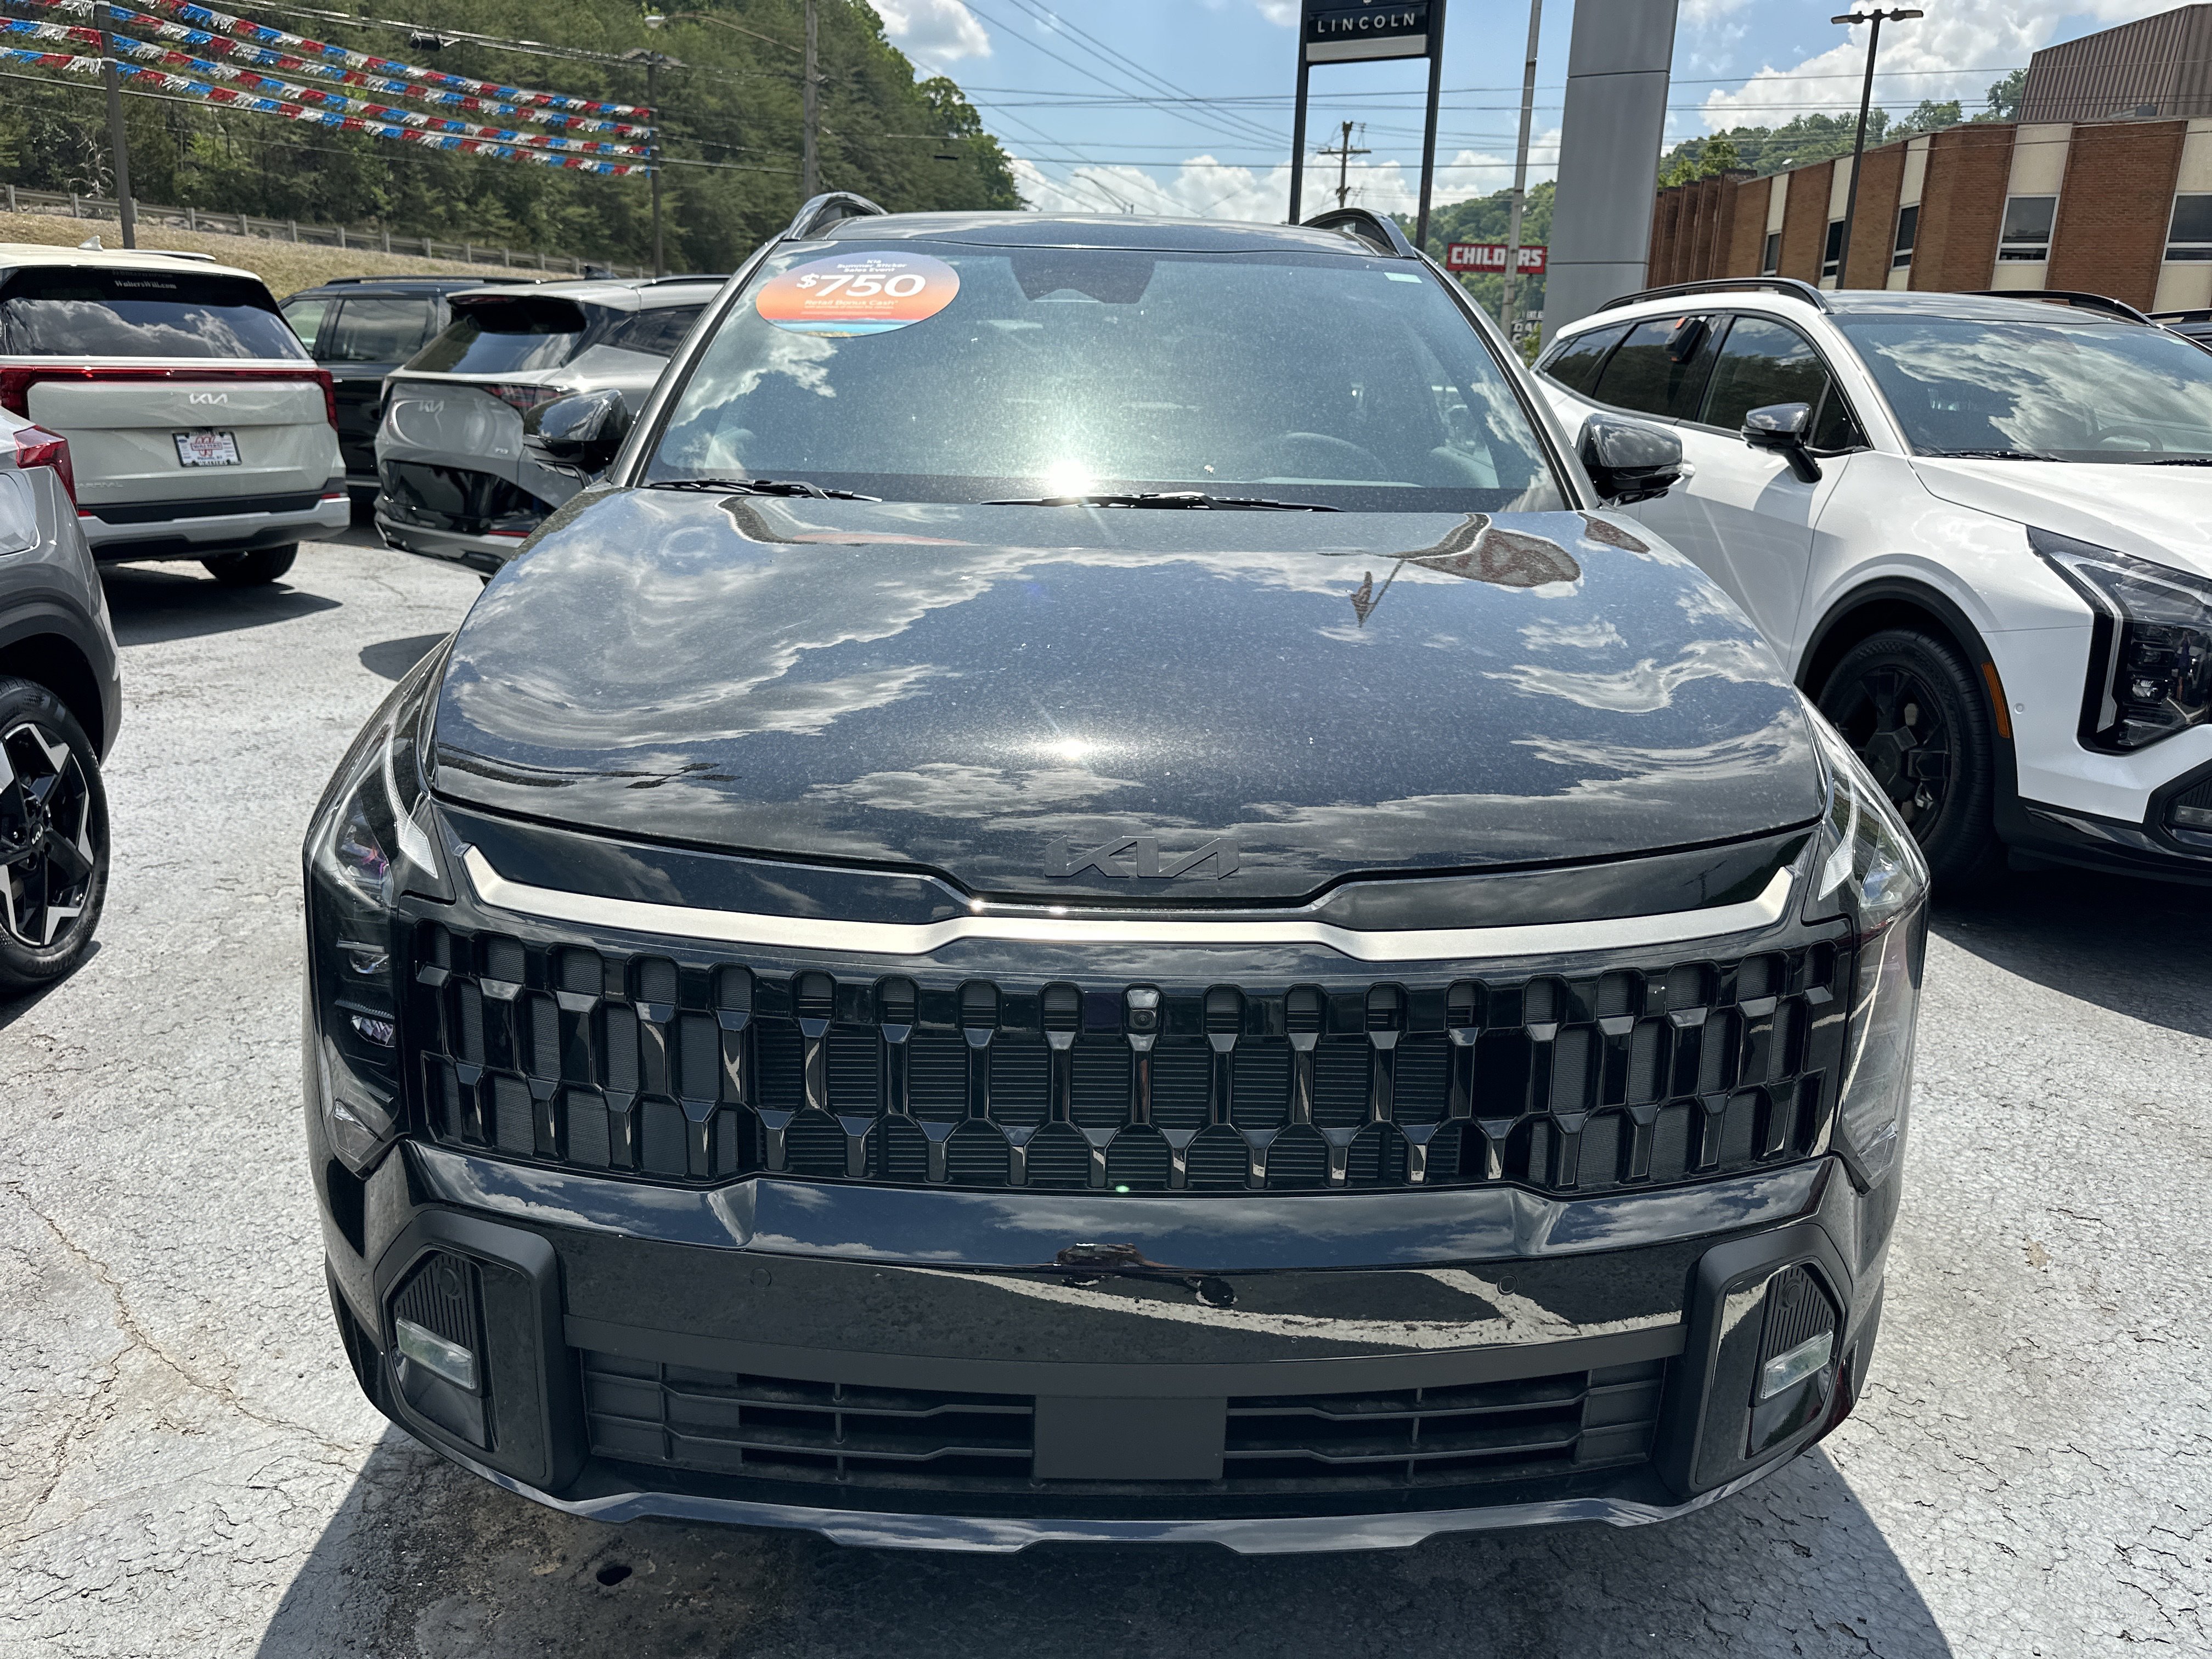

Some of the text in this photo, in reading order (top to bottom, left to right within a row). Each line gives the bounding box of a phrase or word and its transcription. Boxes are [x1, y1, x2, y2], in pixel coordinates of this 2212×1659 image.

[1317, 12, 1416, 33] LINCOLN
[1451, 246, 1543, 267] CHILDRS
[796, 273, 926, 297] $750
[189, 393, 228, 404] KIA
[1044, 834, 1240, 881] KIA
